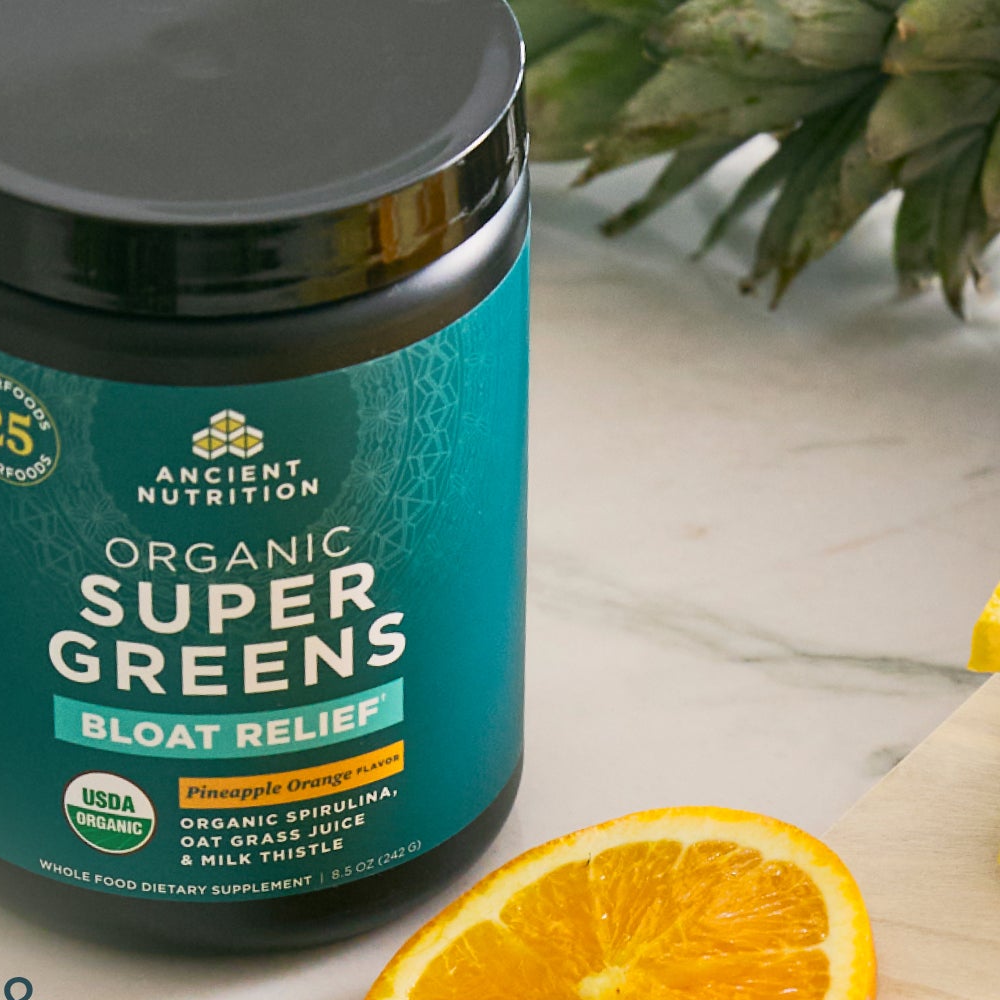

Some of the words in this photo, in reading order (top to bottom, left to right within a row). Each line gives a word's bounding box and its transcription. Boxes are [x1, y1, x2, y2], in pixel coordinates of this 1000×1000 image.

[155, 459, 301, 484] ANCIENT
[137, 477, 319, 506] NUTRITION
[104, 525, 351, 574] ORGANIC
[79, 561, 377, 634] SUPER
[48, 611, 407, 696] GREENS
[81, 711, 221, 750] BLOAT
[186, 781, 282, 801] Pineapple
[286, 770, 353, 792] Orange
[356, 753, 400, 775] FLAVOR
[81, 787, 136, 814] USDA
[179, 813, 279, 830] ORGANIC
[285, 786, 398, 823] SPIRULINA,
[75, 810, 143, 836] ORGANIC
[180, 835, 223, 848] OAT
[230, 829, 301, 847] GRASS
[308, 813, 366, 838] JUICE
[180, 854, 193, 867] &
[201, 853, 252, 867] MILK
[260, 838, 344, 864] THISTLE
[38, 858, 91, 882] WHOLE
[94, 874, 137, 890] FOOD
[141, 882, 207, 896] DIETARY
[211, 875, 313, 896] SUPPLEMENT
[331, 865, 353, 880] 8.5
[355, 858, 375, 873] OZ
